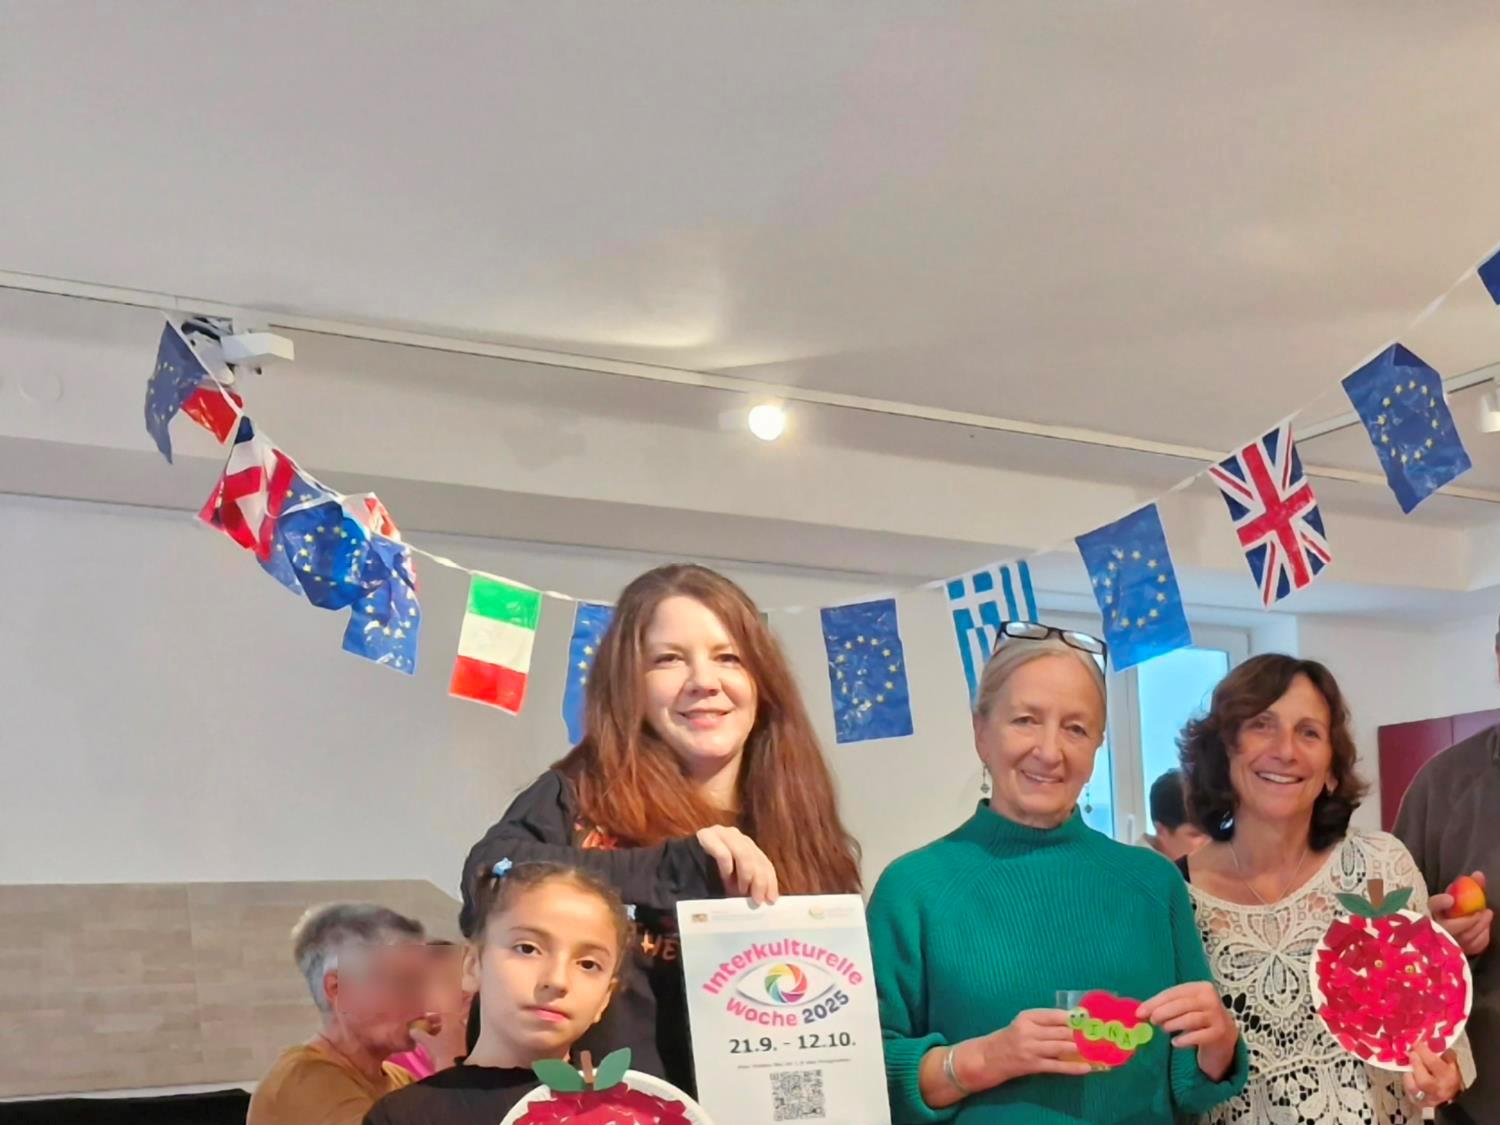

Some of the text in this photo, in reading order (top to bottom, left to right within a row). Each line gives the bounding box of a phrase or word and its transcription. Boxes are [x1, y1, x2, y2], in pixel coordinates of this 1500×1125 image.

[702, 938, 863, 995] Interkulturelle
[802, 990, 849, 1024] 2025
[729, 1036, 777, 1054] 21.9.
[797, 1031, 856, 1050] 12.10.
